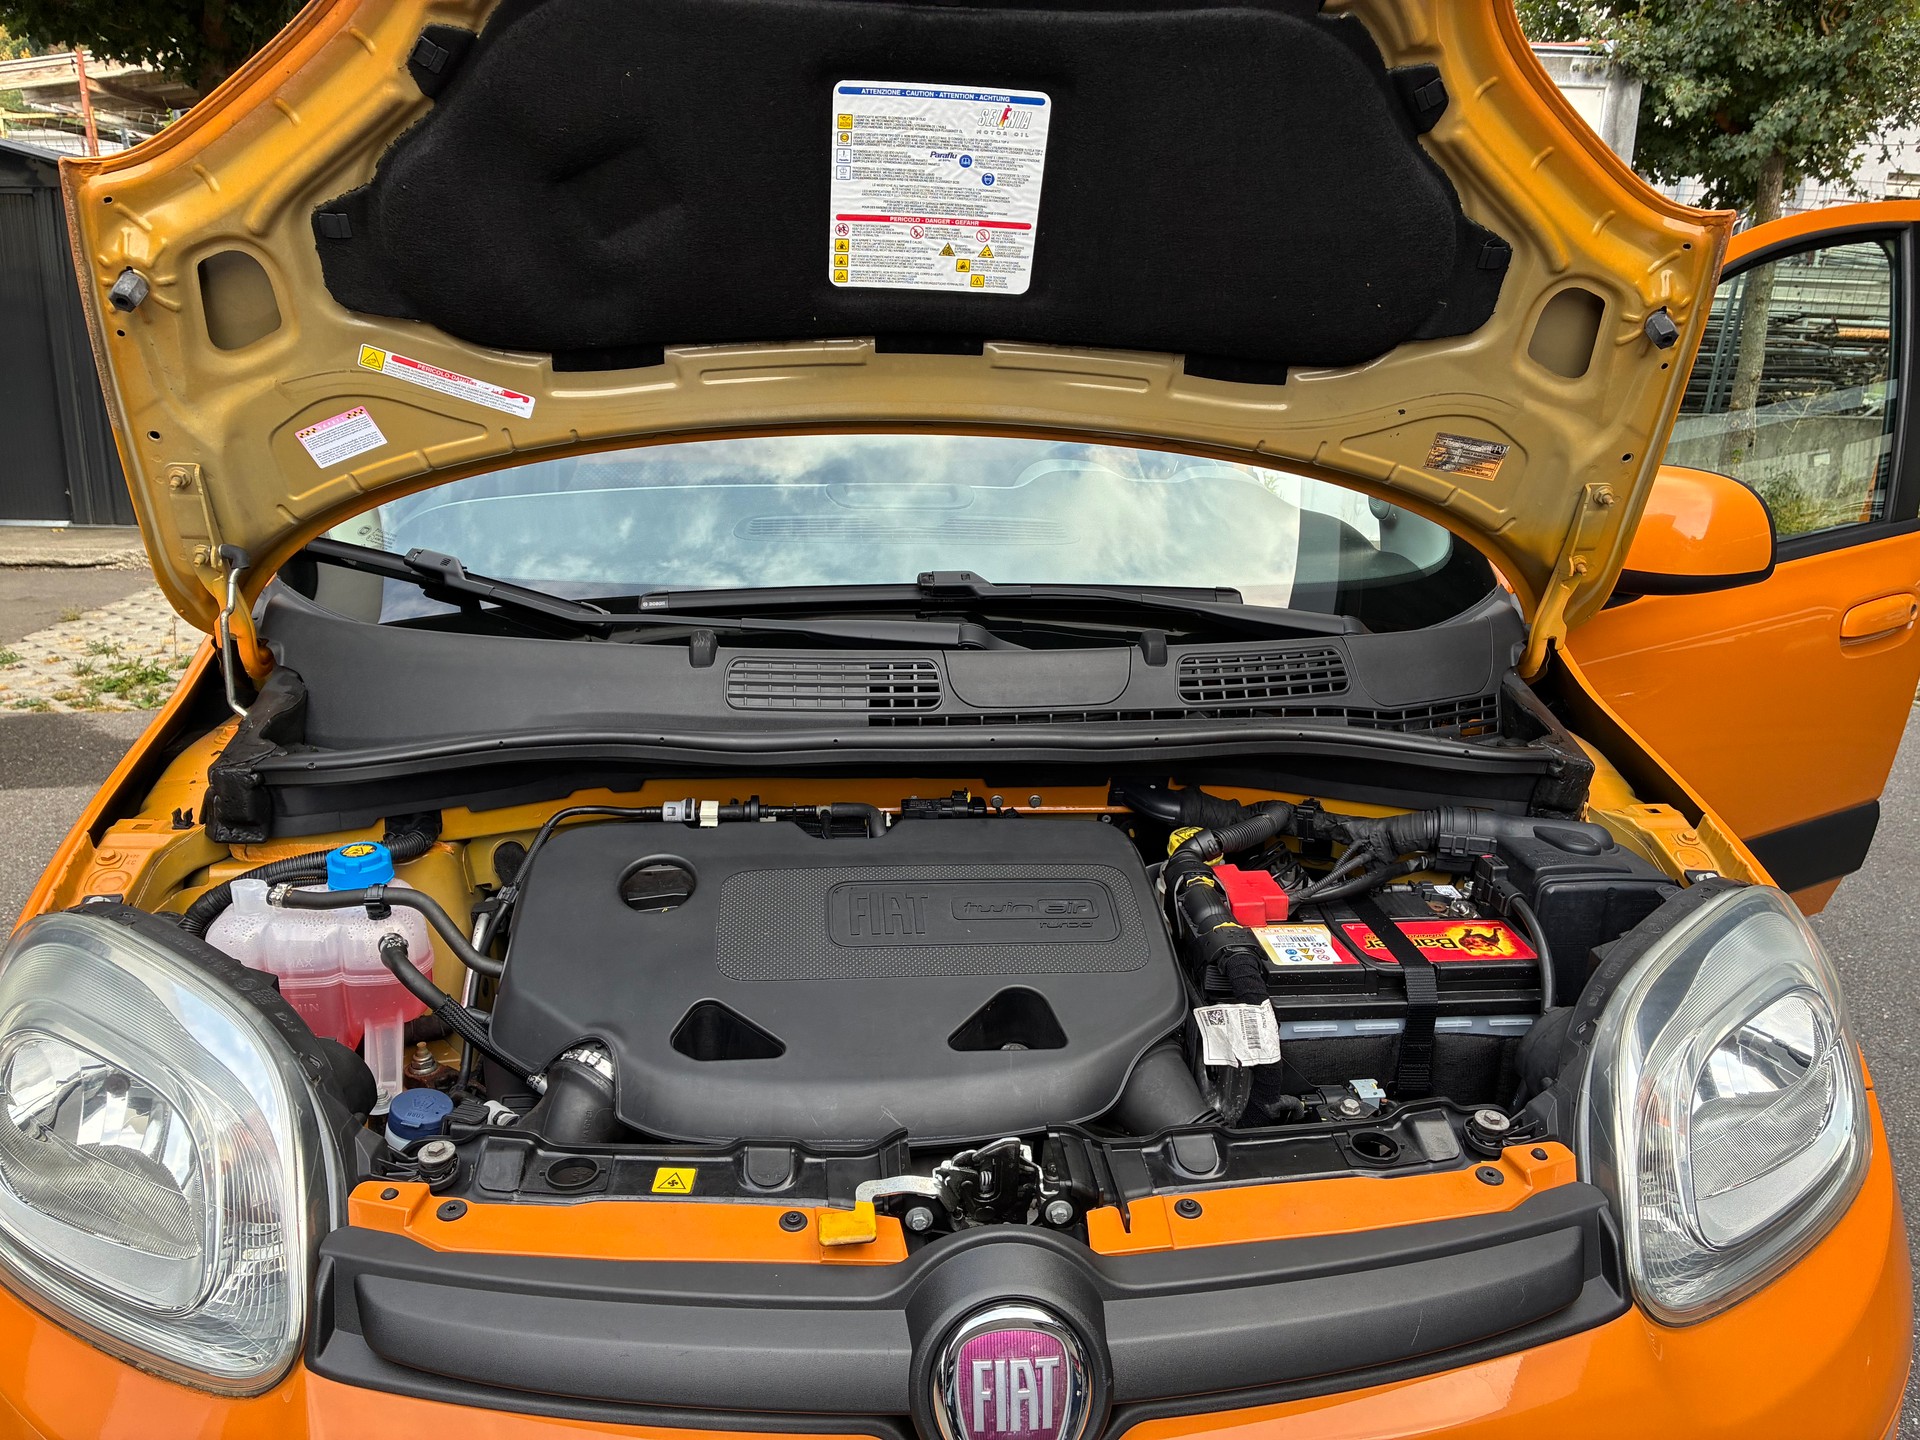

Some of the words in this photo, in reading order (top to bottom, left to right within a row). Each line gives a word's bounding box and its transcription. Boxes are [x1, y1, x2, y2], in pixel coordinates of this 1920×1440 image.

[861, 88, 901, 96] ATTENZIONE
[979, 94, 1010, 102] ACHTUNG
[930, 150, 958, 159] Paraflu
[889, 216, 920, 224] PERICOLO
[925, 217, 951, 225] DANGER
[850, 891, 929, 936] FIAT
[286, 958, 313, 968] MAX
[971, 1355, 1060, 1433] FIAT
